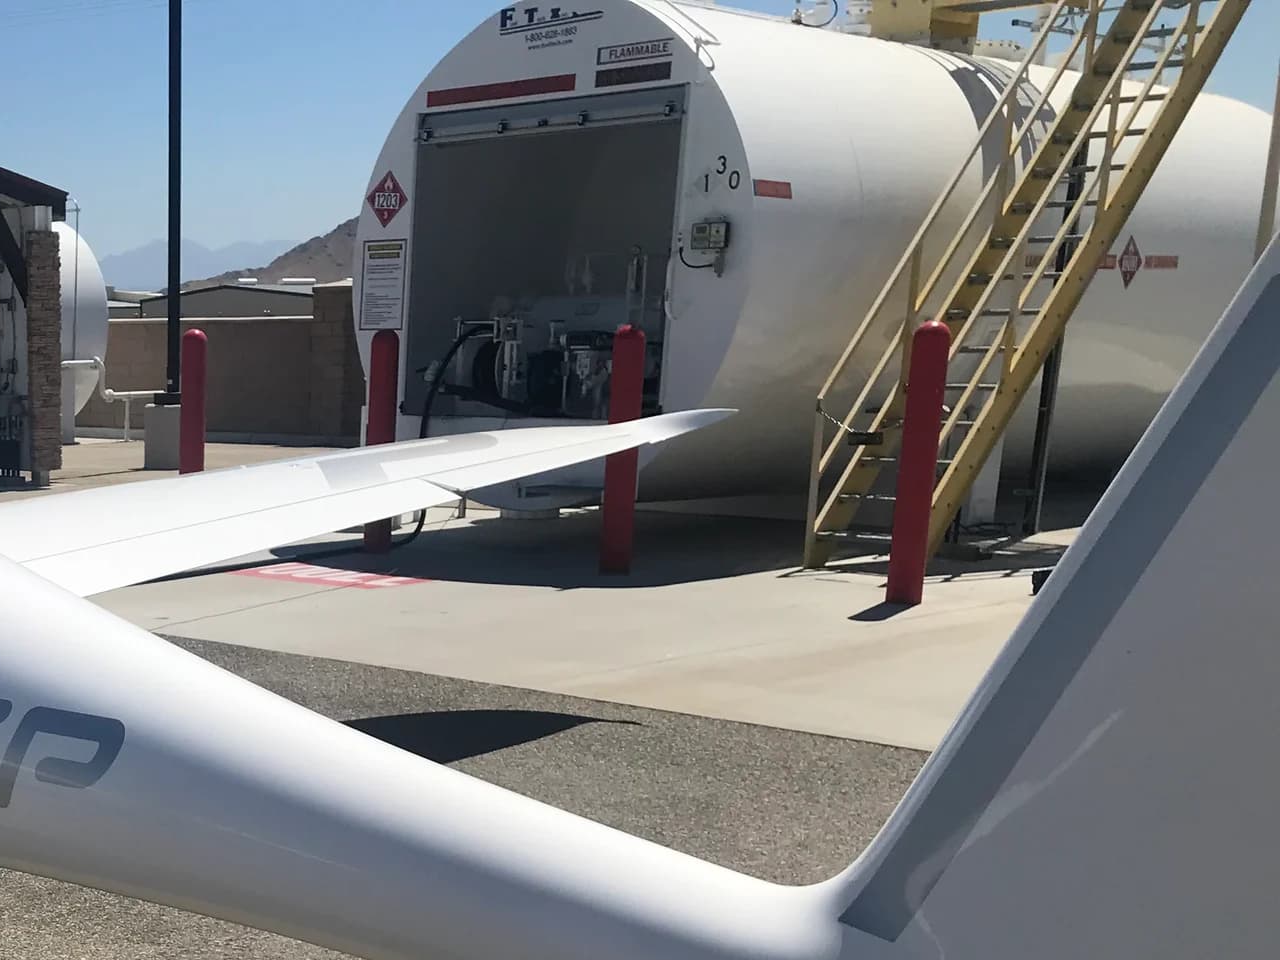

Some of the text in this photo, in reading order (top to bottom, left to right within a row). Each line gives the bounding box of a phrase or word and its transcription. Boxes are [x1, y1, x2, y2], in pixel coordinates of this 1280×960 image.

[608, 42, 669, 60] FLAMMABLE
[716, 155, 727, 174] 3
[704, 174, 709, 192] 1
[376, 193, 399, 208] 1203
